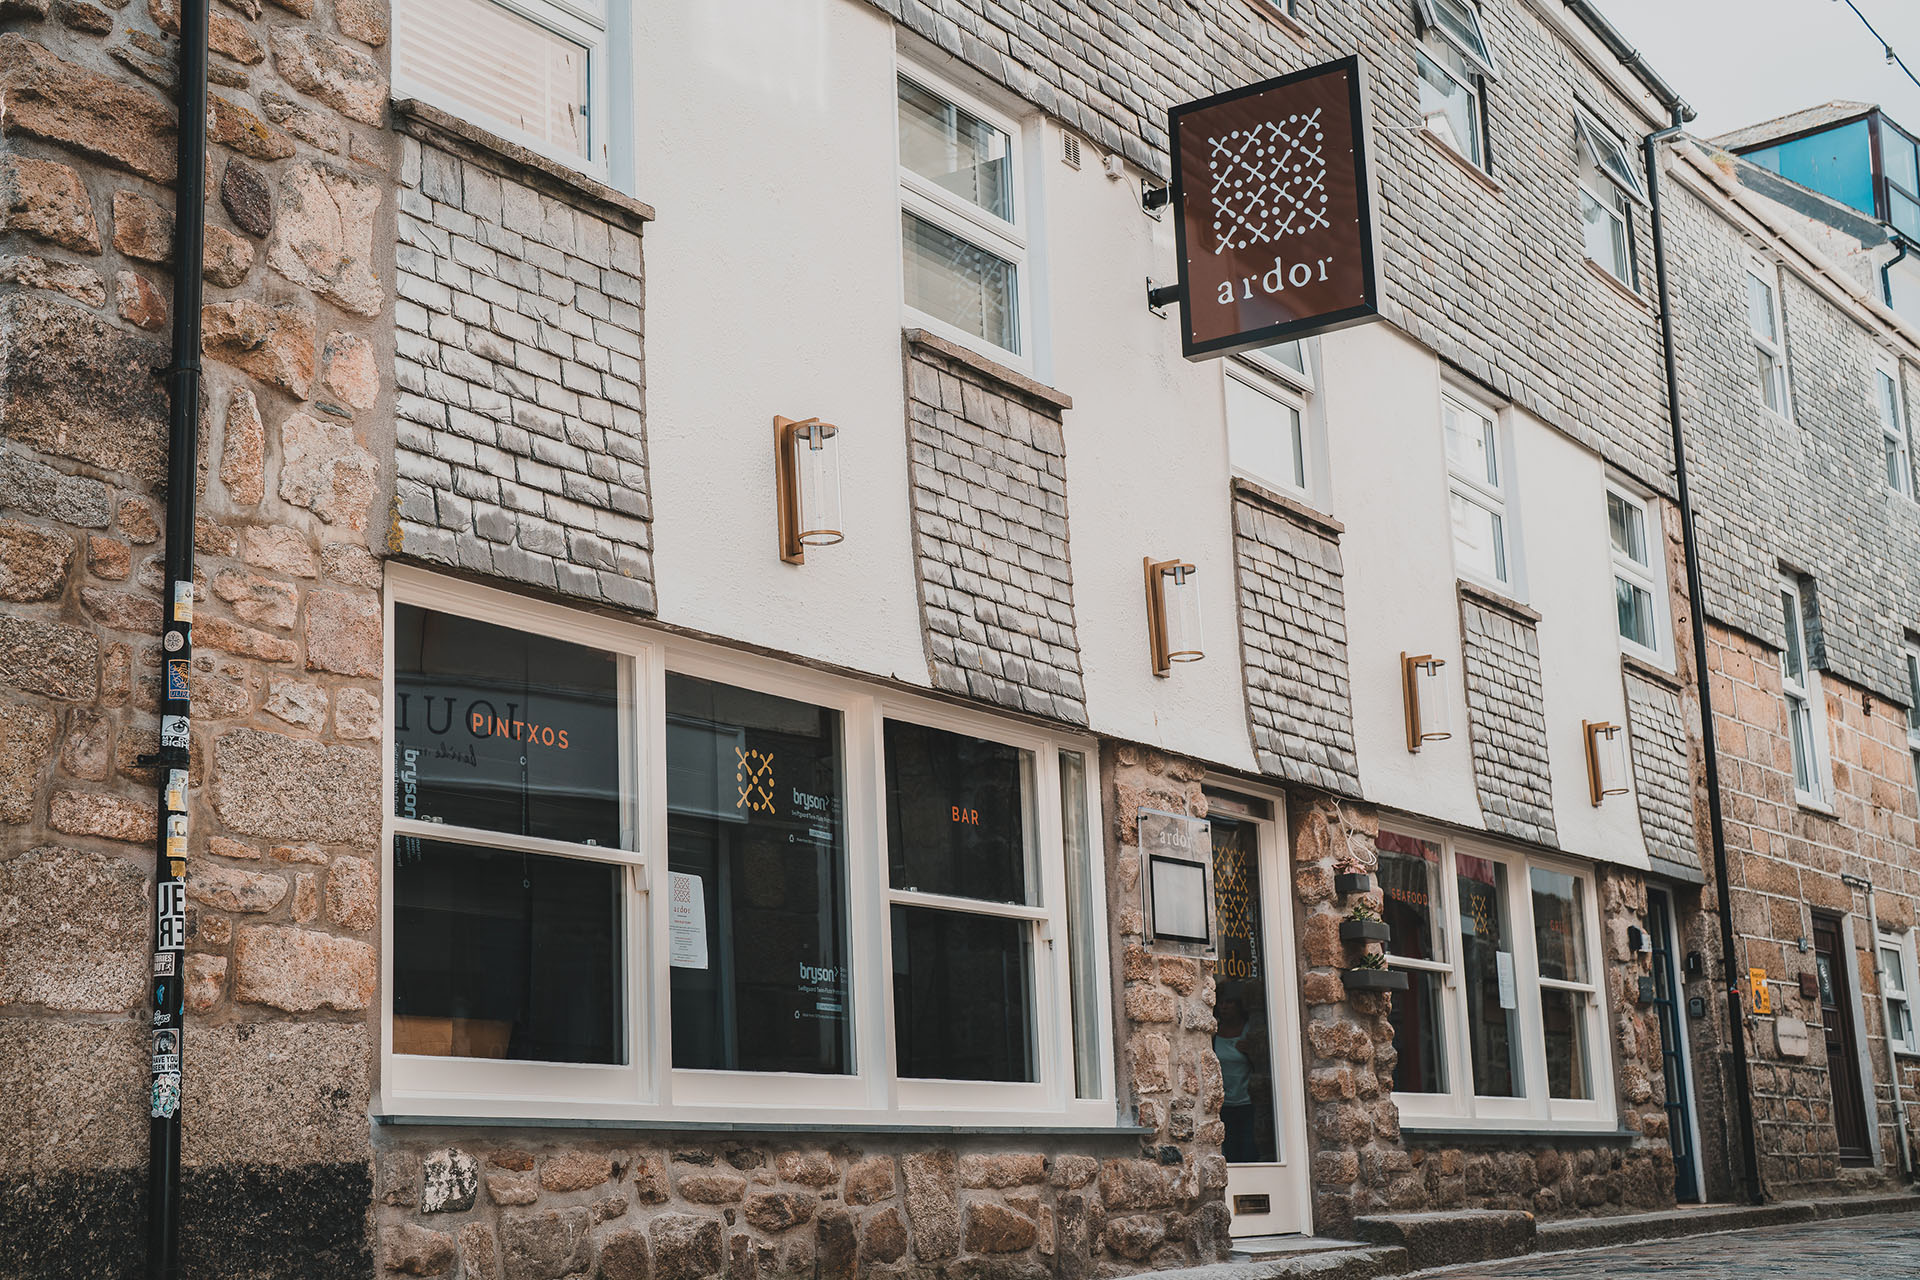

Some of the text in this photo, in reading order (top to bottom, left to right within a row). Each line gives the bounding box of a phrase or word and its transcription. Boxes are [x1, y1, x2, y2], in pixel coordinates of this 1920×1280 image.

[1217, 256, 1333, 305] ardor
[472, 713, 569, 749] PINTXOS
[401, 748, 419, 819] bryson
[793, 787, 827, 811] bryson
[952, 805, 979, 826] BAR
[1160, 828, 1191, 848] ardor
[160, 884, 183, 916] JE
[1391, 887, 1428, 905] SEAFOOD
[799, 962, 835, 984] bryson
